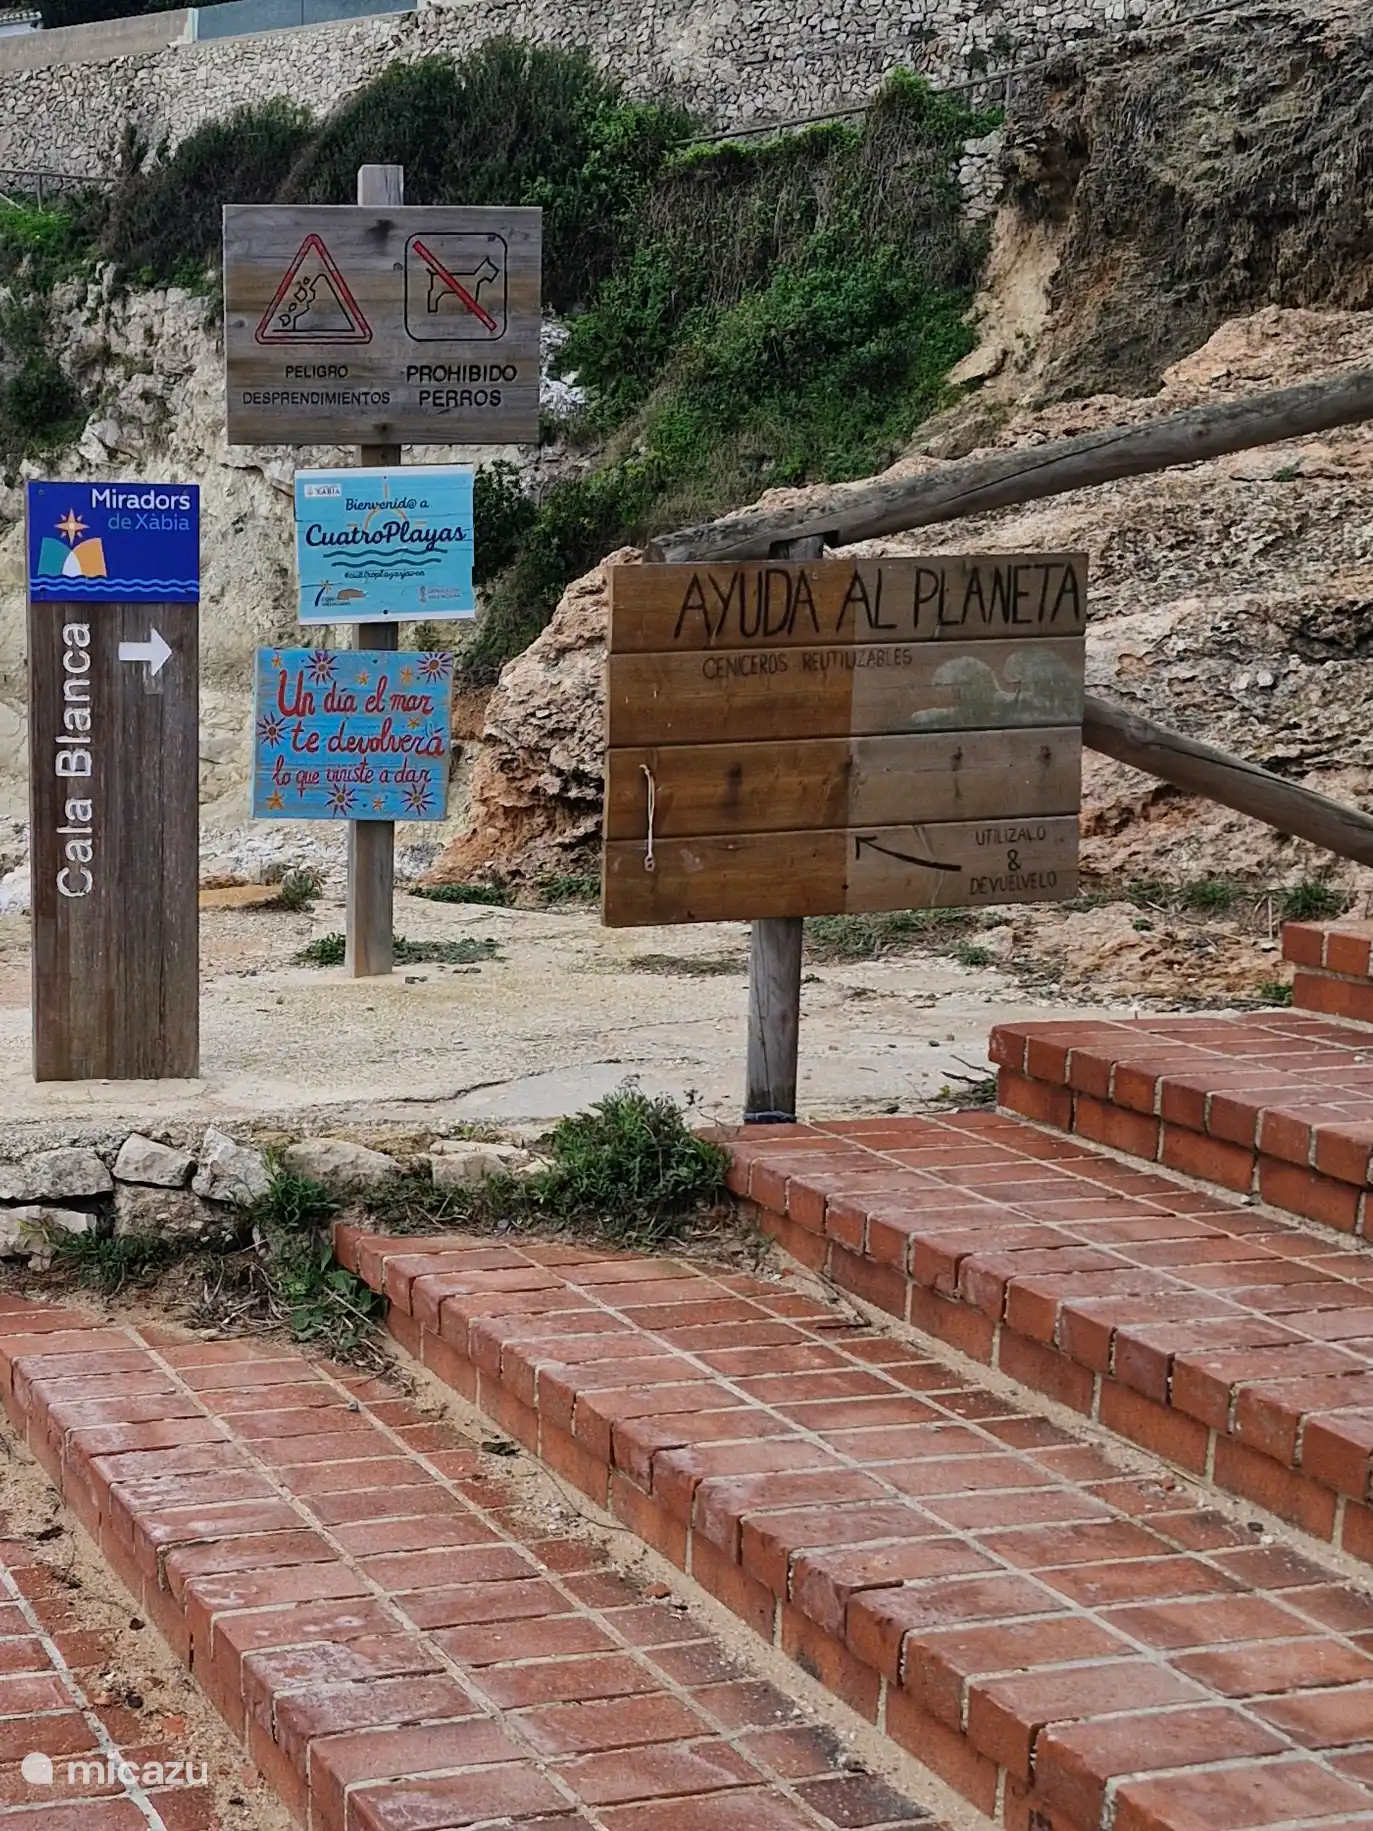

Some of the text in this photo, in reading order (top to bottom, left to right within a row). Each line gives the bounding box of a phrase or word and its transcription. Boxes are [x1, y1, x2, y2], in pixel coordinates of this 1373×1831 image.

[285, 365, 348, 379] PELIGRO
[406, 365, 518, 382] PROHIBIDO
[242, 391, 391, 405] DESPRENDIMIENTOS
[419, 390, 502, 407] PERROS
[92, 488, 191, 511] Miradors
[345, 496, 429, 511] Bienvenid@ a
[108, 512, 190, 531] de Xàbia
[305, 521, 467, 550] CuatroPlayas
[673, 562, 1080, 640] AYUDA AL PLANETA
[702, 652, 789, 680] CENICEROS
[277, 669, 435, 718] Un día el mar
[290, 716, 445, 758] te devolverá
[55, 622, 93, 898] Cala Blanca
[272, 754, 432, 798] lo que viniste a dar
[975, 825, 1046, 846] UTILIZALO
[1007, 849, 1021, 872] &
[969, 870, 1057, 895] DEVUELVELO
